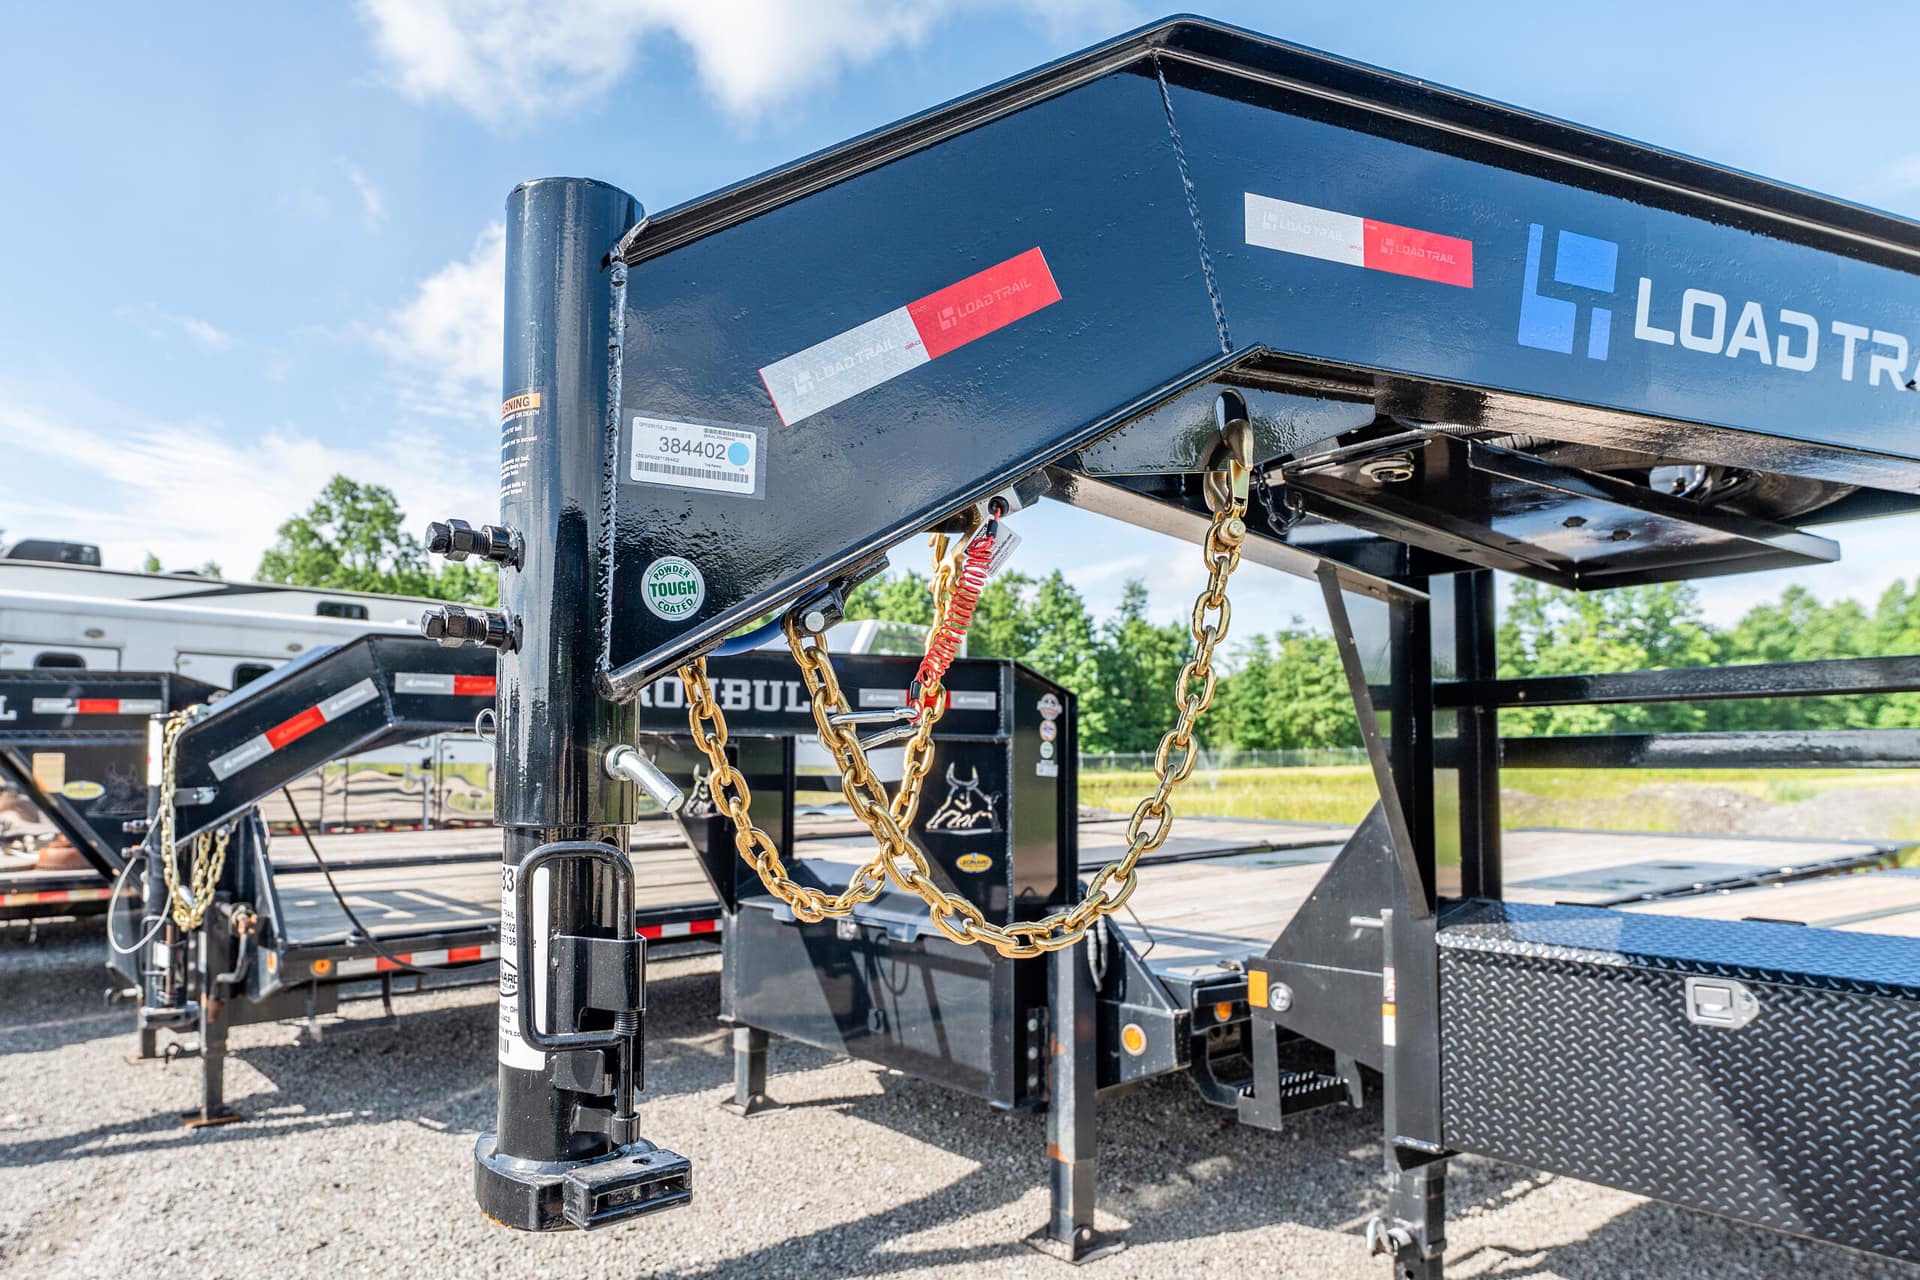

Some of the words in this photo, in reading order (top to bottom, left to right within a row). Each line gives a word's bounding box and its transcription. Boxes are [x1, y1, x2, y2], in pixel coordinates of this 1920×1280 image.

[1395, 242, 1425, 258] LOAD
[1426, 247, 1457, 265] TRAIL
[957, 295, 993, 319] LOAD
[992, 278, 1033, 304] TRAIL
[1634, 276, 1819, 373] LOAD
[814, 358, 854, 382] LOAD
[854, 338, 895, 365] TRAIL
[659, 436, 726, 461] 384402
[653, 565, 690, 580] POWDER
[650, 581, 697, 597] TOUGH
[658, 598, 693, 613] COATED
